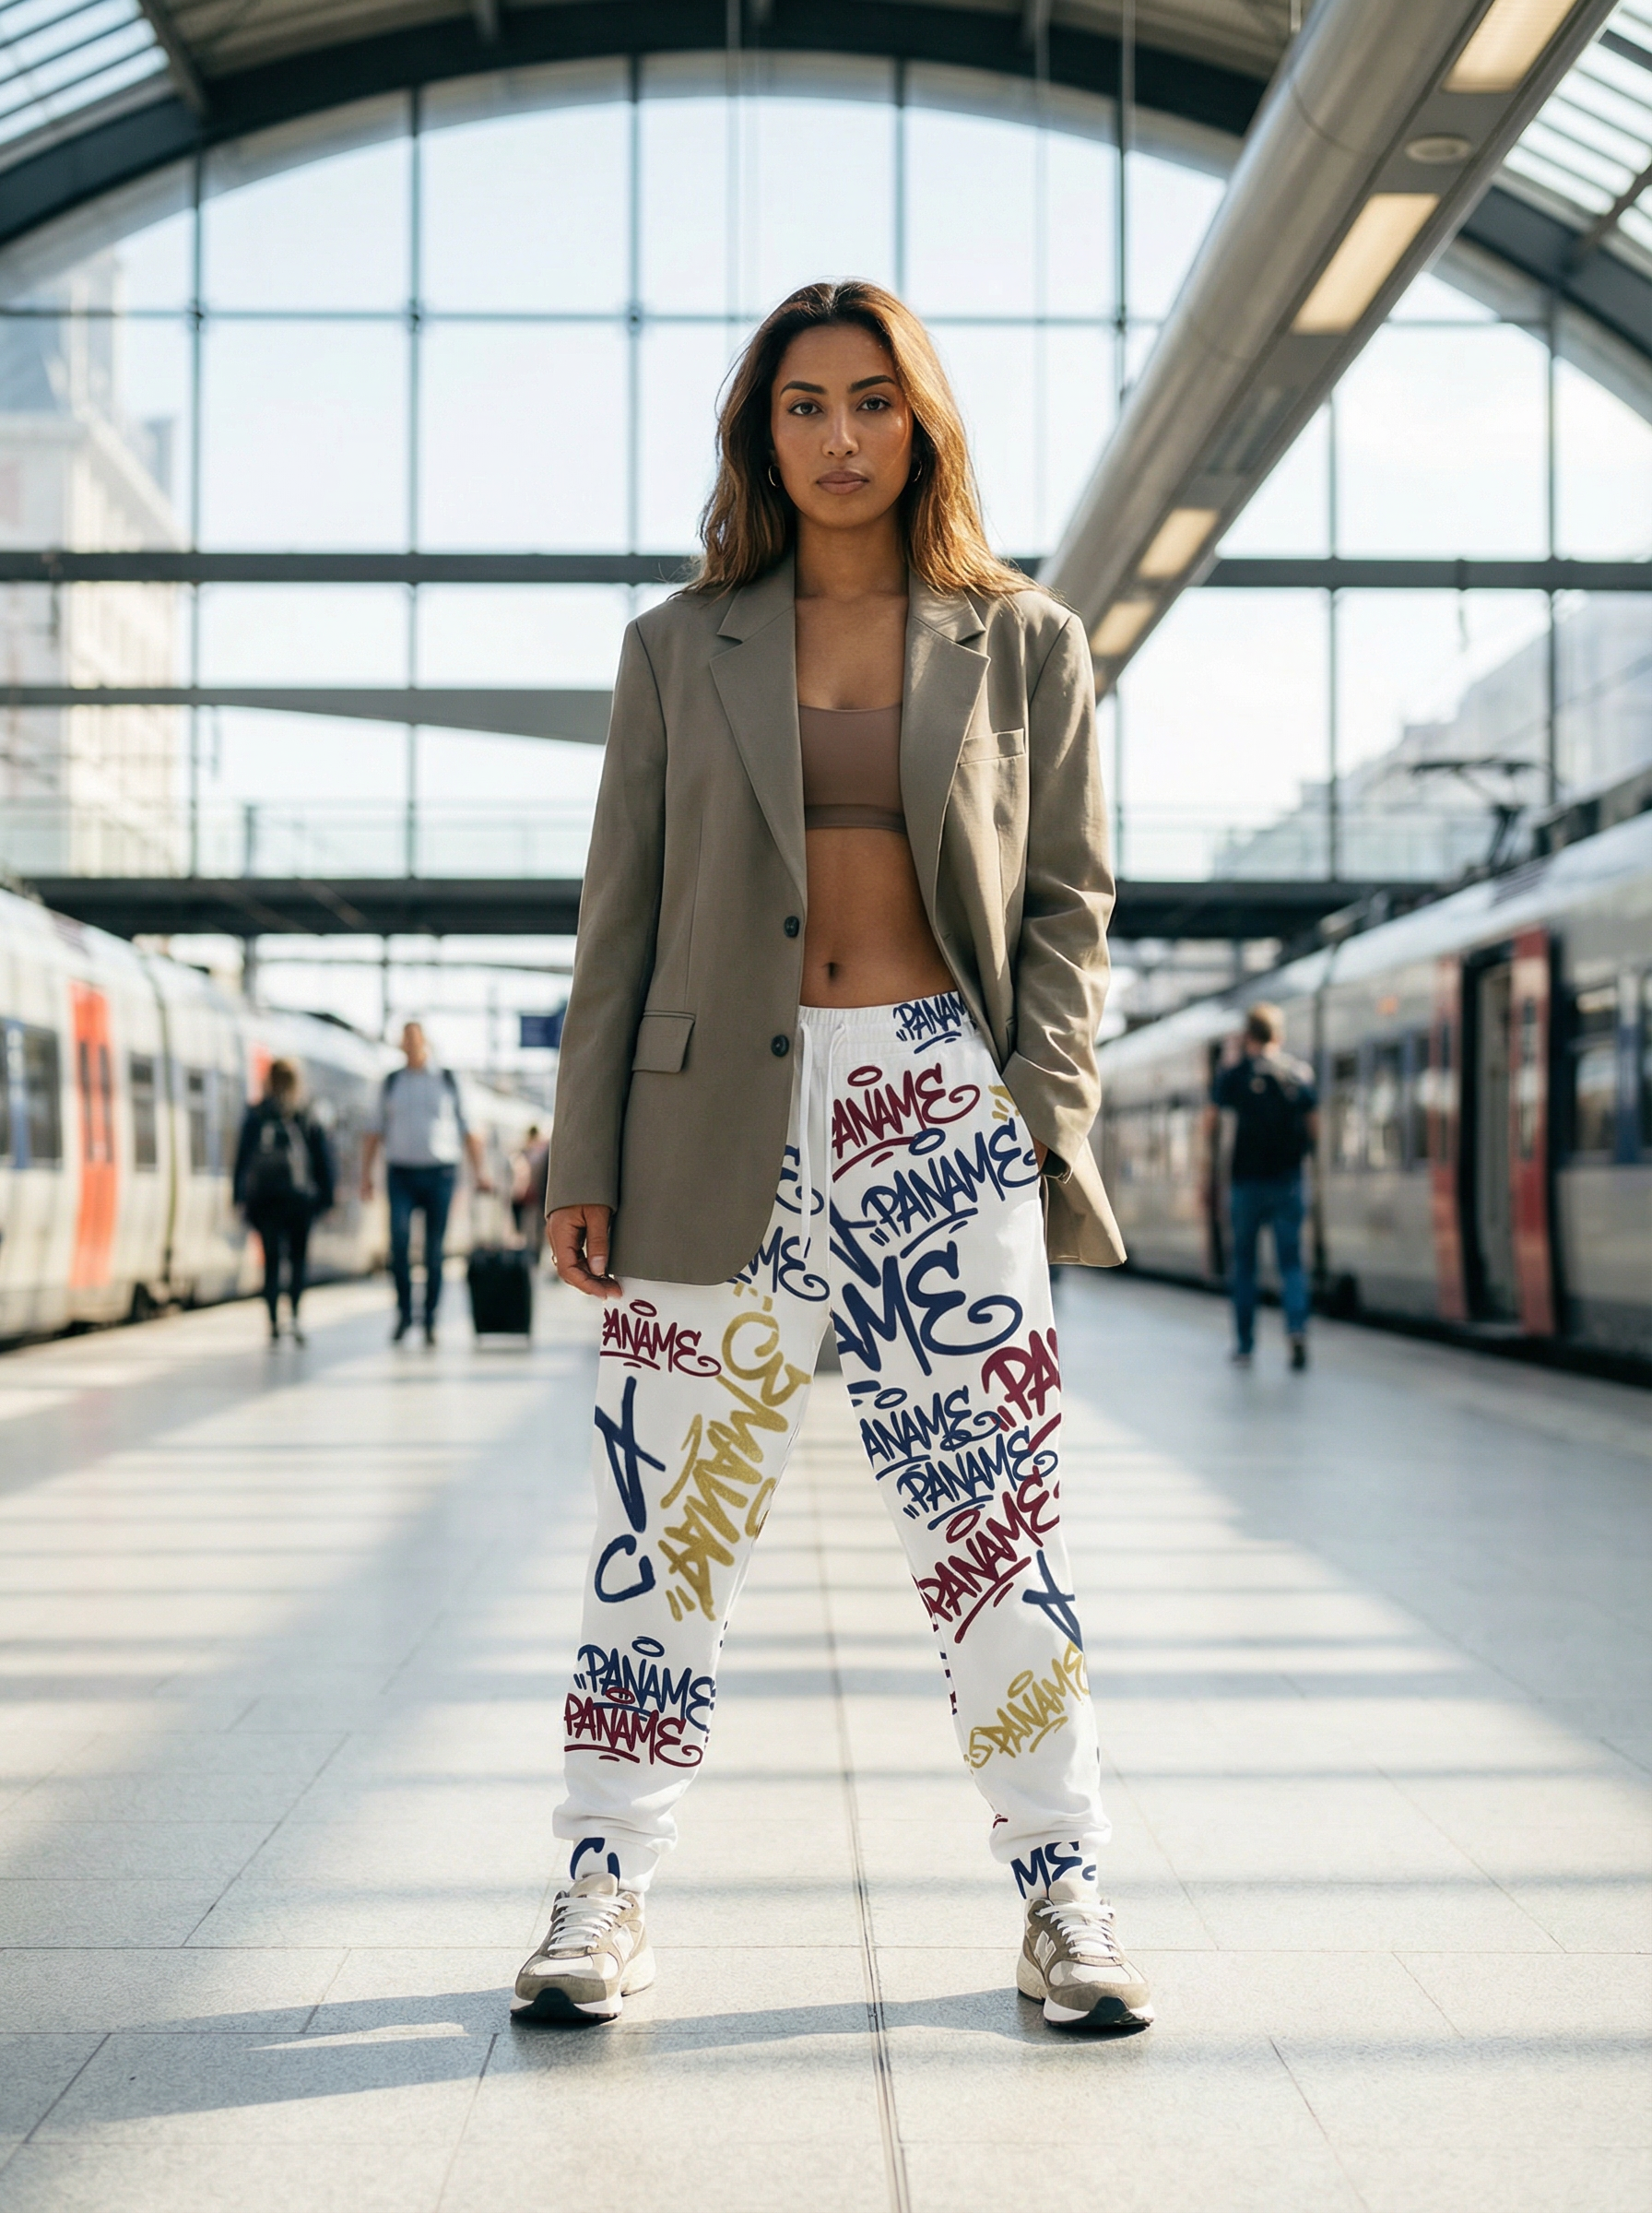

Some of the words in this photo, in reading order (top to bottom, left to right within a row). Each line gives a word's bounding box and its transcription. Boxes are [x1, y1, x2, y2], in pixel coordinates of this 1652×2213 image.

[832, 1062, 981, 1159] ANAME
[861, 1118, 1040, 1237] PANAME
[981, 1327, 1062, 1421] PA
[897, 1426, 1058, 1513] PANAME
[917, 1465, 1060, 1623] PANAME
[564, 1693, 703, 1768] PANAME
[577, 1644, 716, 1734] PANAME
